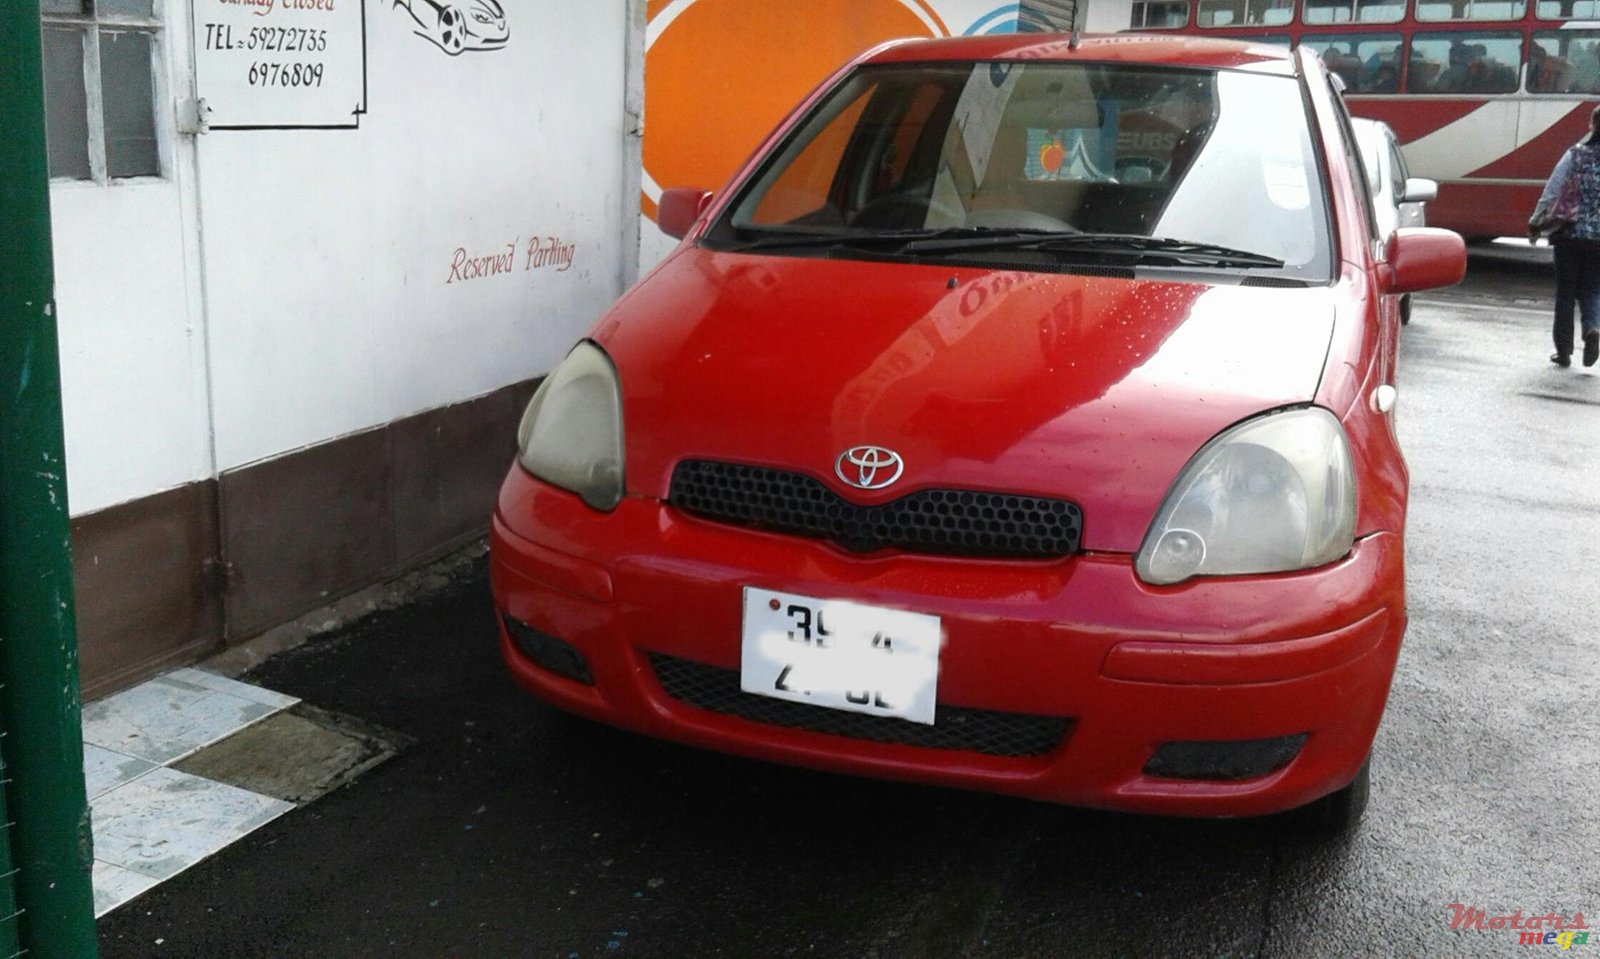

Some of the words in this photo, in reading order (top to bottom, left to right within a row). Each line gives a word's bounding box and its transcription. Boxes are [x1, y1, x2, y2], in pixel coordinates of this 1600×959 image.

[247, 27, 327, 52] 59272735
[248, 61, 324, 87] 6976809
[446, 241, 515, 283] Reserved
[525, 236, 576, 272] Parking
